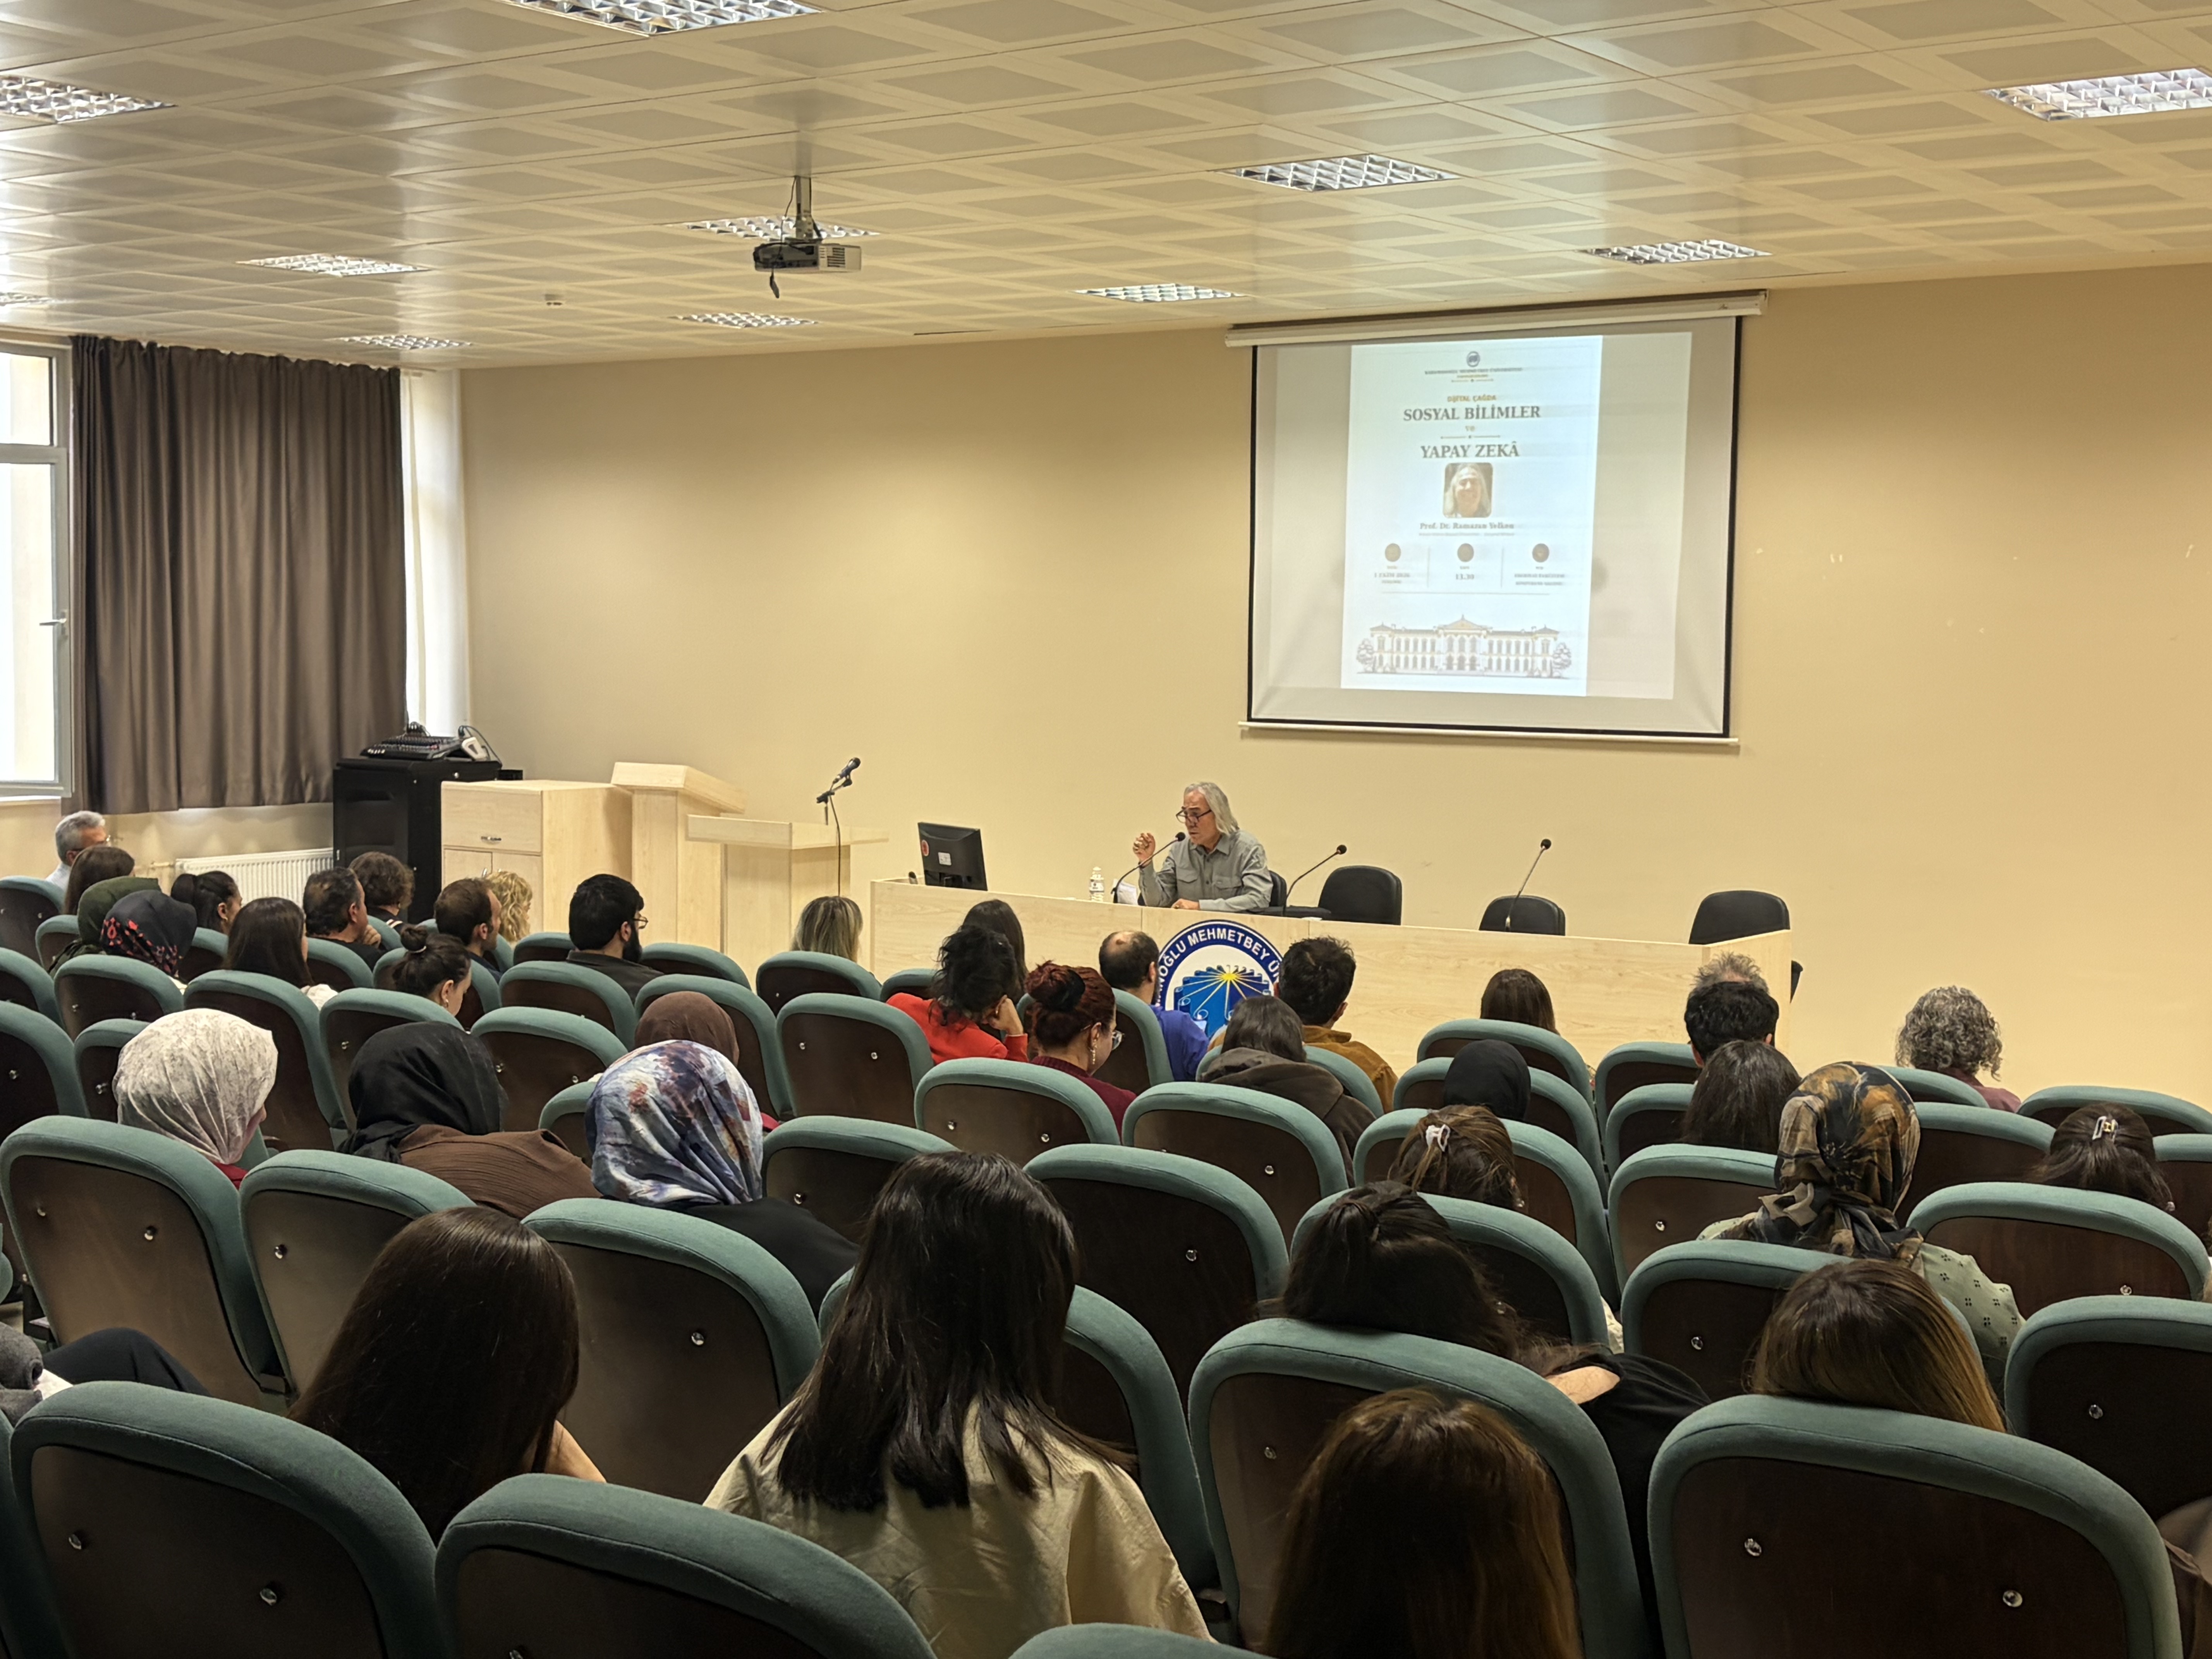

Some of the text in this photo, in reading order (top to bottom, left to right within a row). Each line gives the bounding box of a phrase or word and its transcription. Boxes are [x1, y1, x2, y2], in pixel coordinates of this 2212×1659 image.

[1403, 404, 1540, 421] SOSYAL BİLİMLER
[1420, 441, 1519, 458] YAPAY ZEKÂ
[1188, 928, 1270, 960] MEHMETBEY
